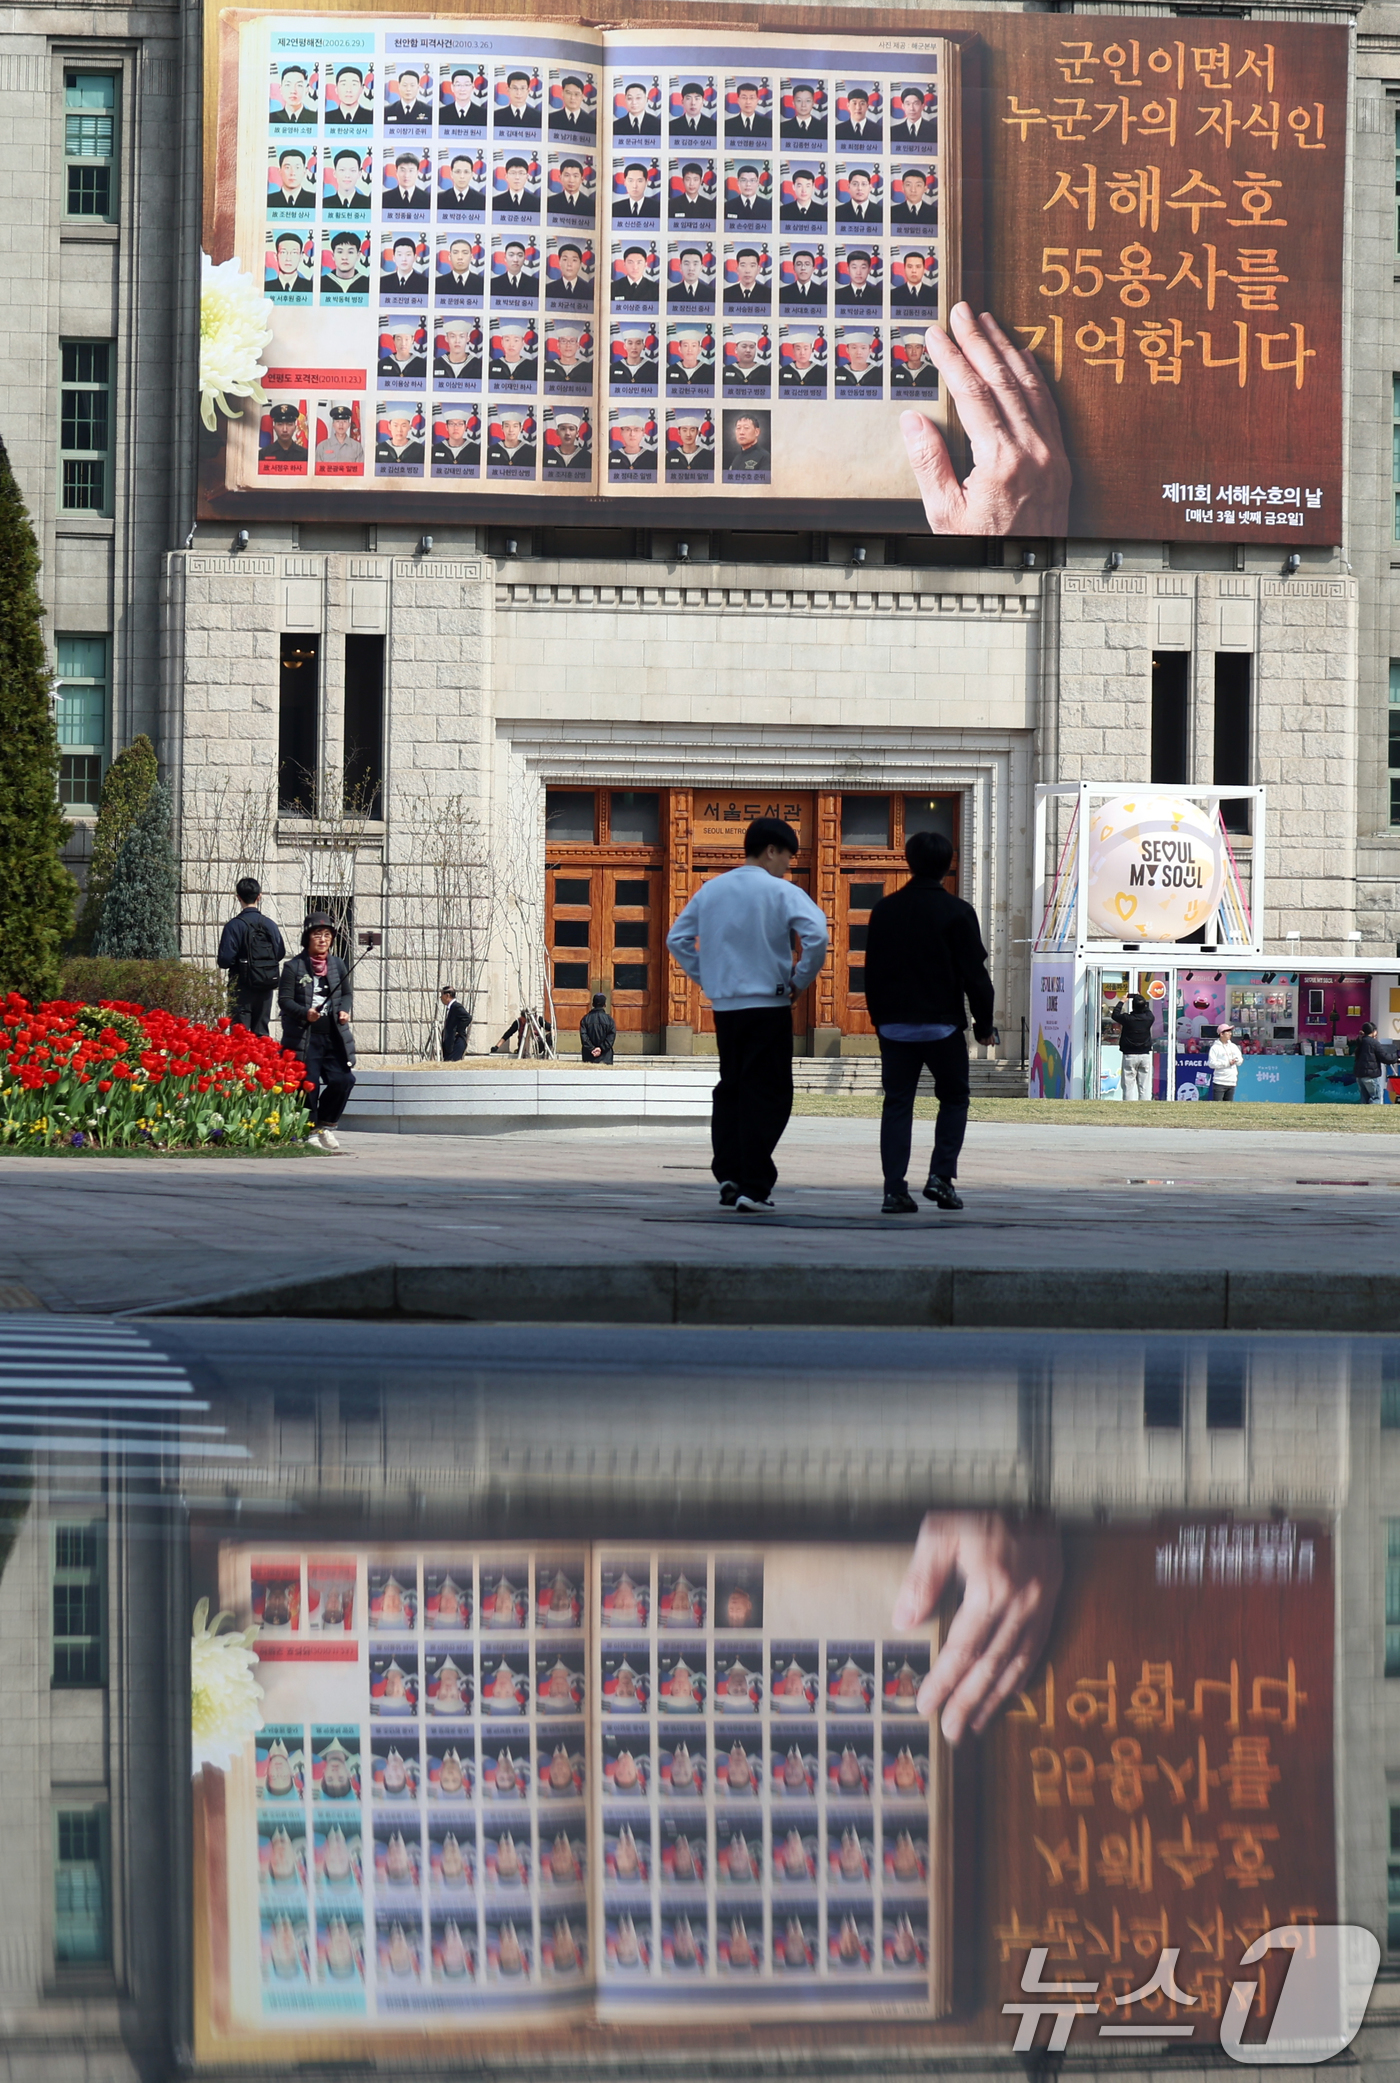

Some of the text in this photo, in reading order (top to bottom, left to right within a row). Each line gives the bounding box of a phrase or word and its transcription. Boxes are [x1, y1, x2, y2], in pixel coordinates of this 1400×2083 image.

[394, 38, 418, 48] 천안함
[1054, 38, 1275, 94] 군인이면서
[1001, 95, 1327, 150] 누군가의 자식인
[1042, 162, 1289, 234] 서해수호
[1039, 241, 1289, 311] 55용사를
[1014, 314, 1317, 390] 기억합니다
[268, 373, 292, 383] 연평도
[1161, 482, 1323, 509] 제11회 서해수호의 날
[1185, 508, 1304, 526] [매년 3월 넷째 금요일]
[703, 802, 802, 822] 서울도서관
[703, 827, 723, 835] SEOUL
[1161, 864, 1203, 889] SOUL
[1255, 1070, 1280, 1083] 해치
